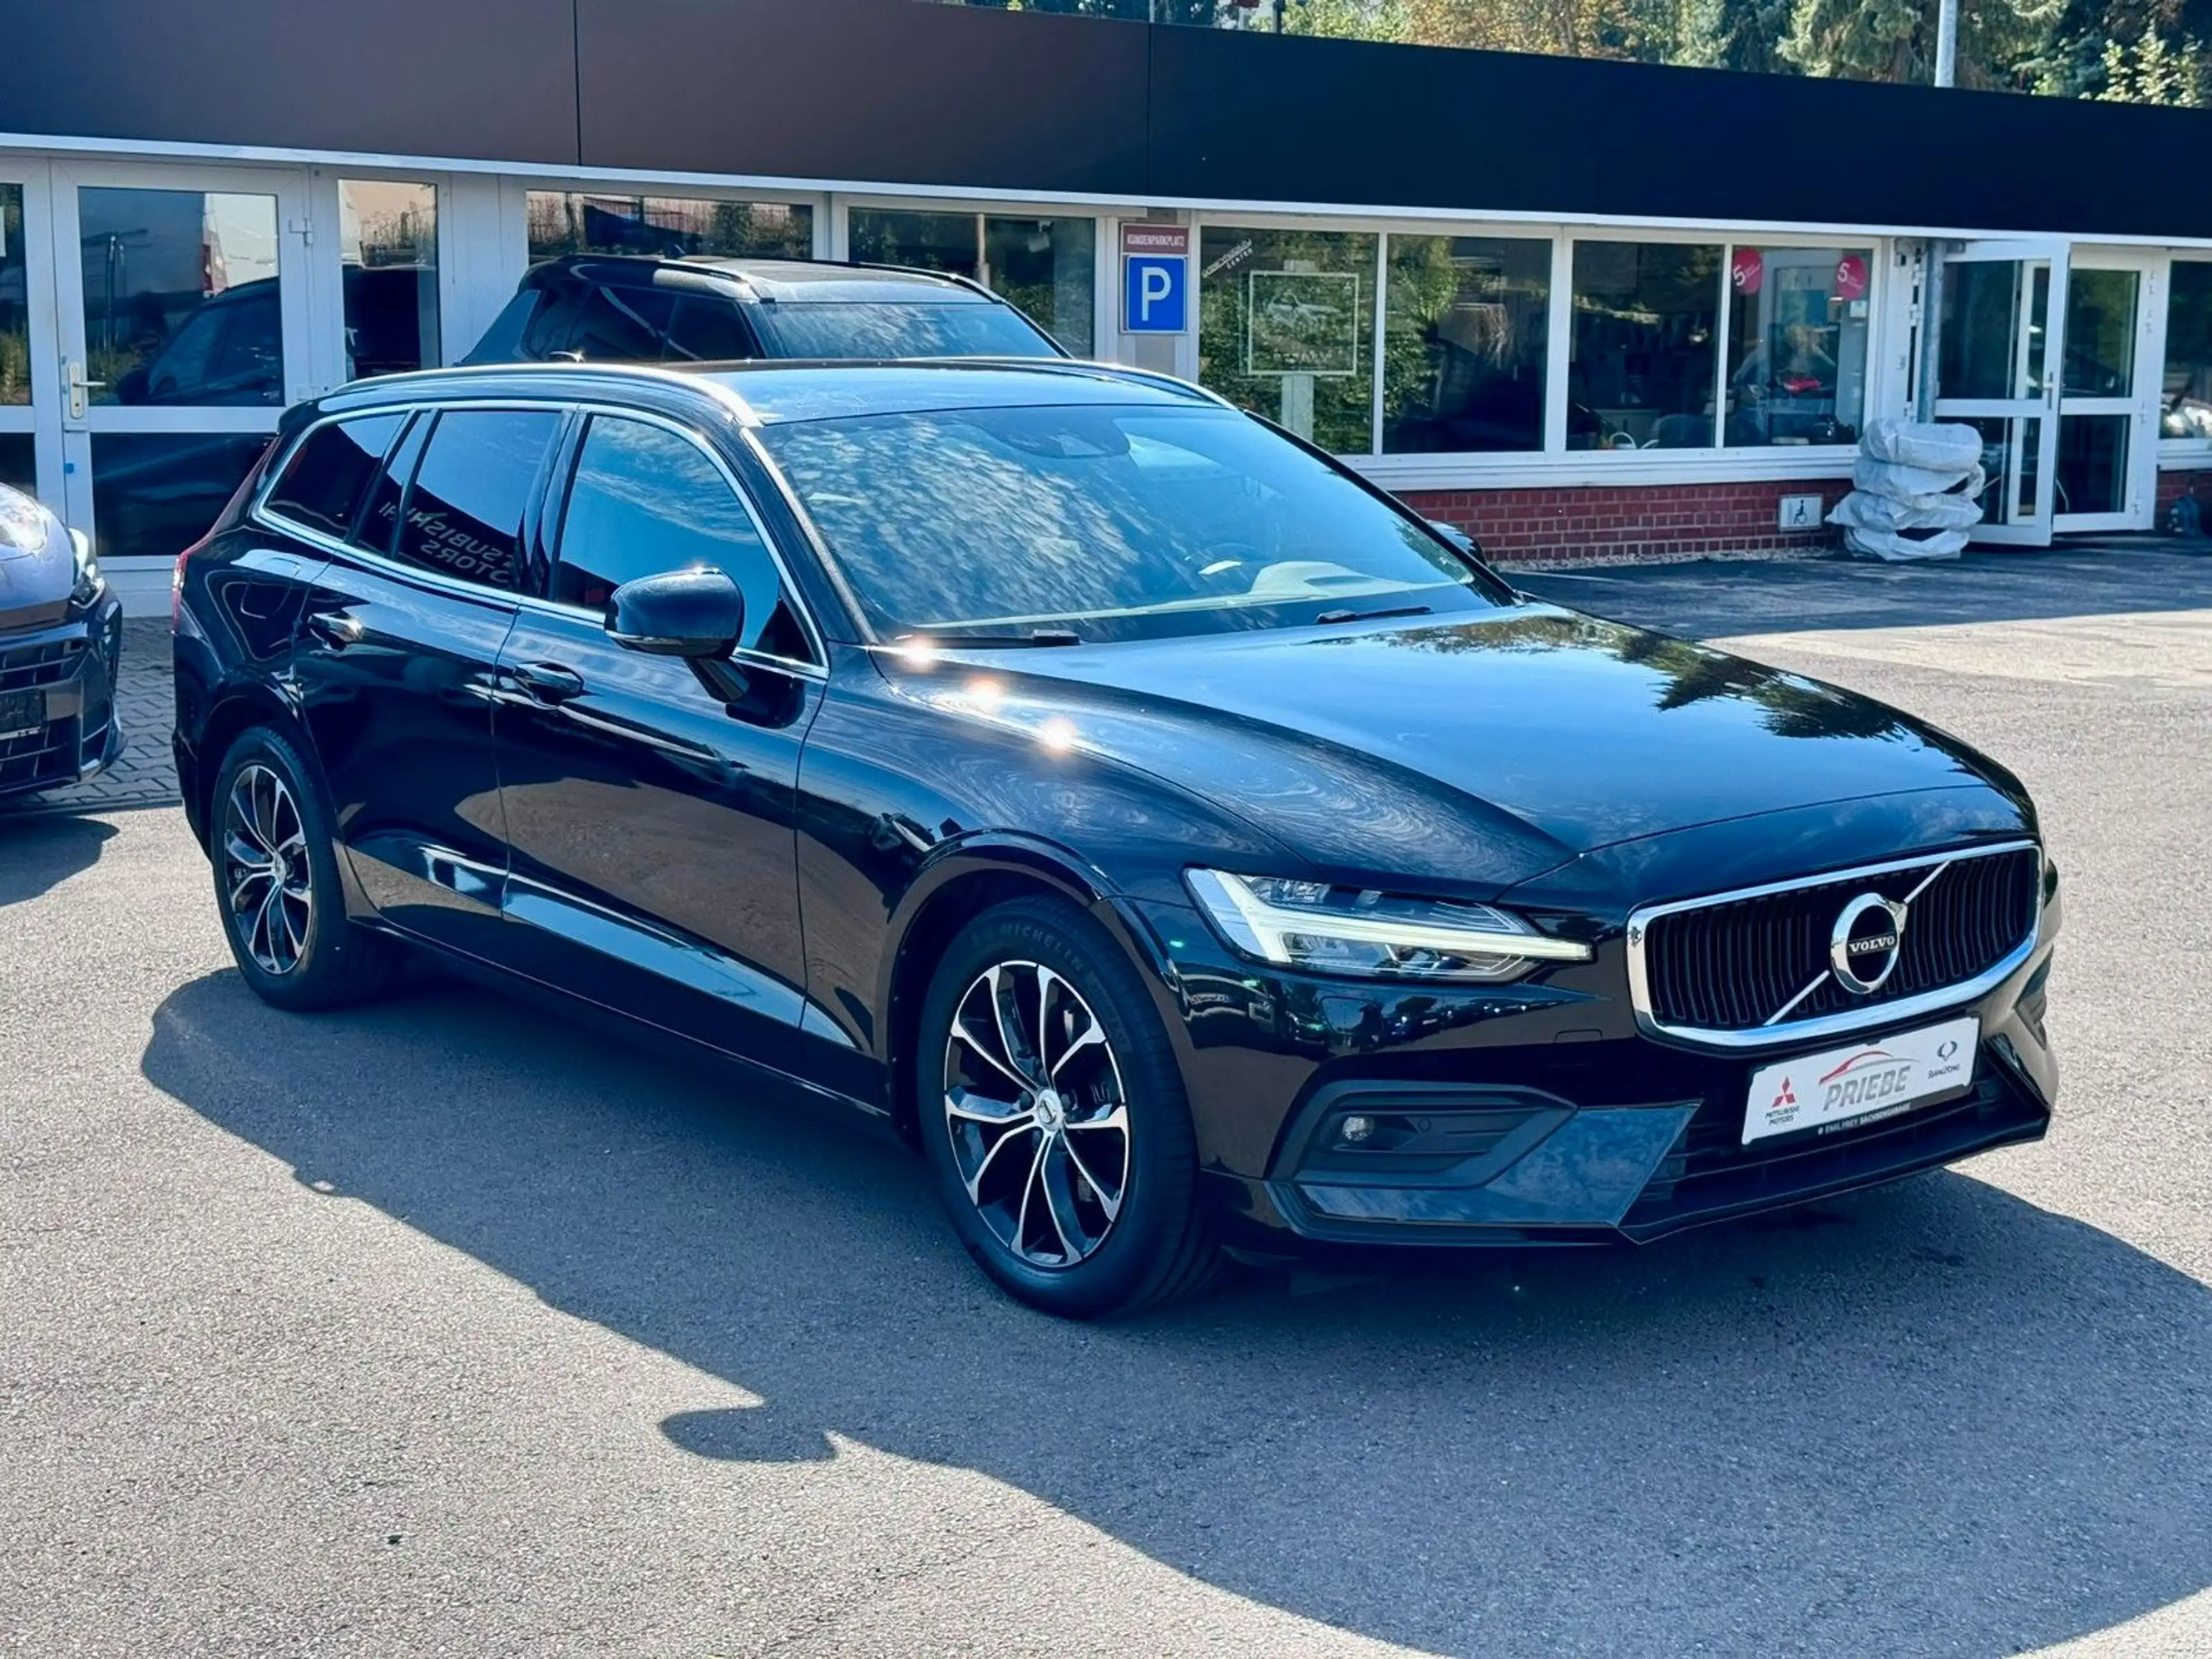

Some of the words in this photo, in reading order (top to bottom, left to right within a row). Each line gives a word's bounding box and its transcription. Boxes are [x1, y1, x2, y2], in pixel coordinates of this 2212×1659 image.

[1127, 233, 1184, 247] KUNDENPARKPLATZ
[1733, 264, 1746, 286] 5
[1837, 263, 1850, 283] 5
[1142, 267, 1172, 321] P
[1000, 922, 1084, 971] MICHELIN
[1849, 935, 1896, 952] VOLVO
[1823, 1065, 1911, 1112] PRIEBE
